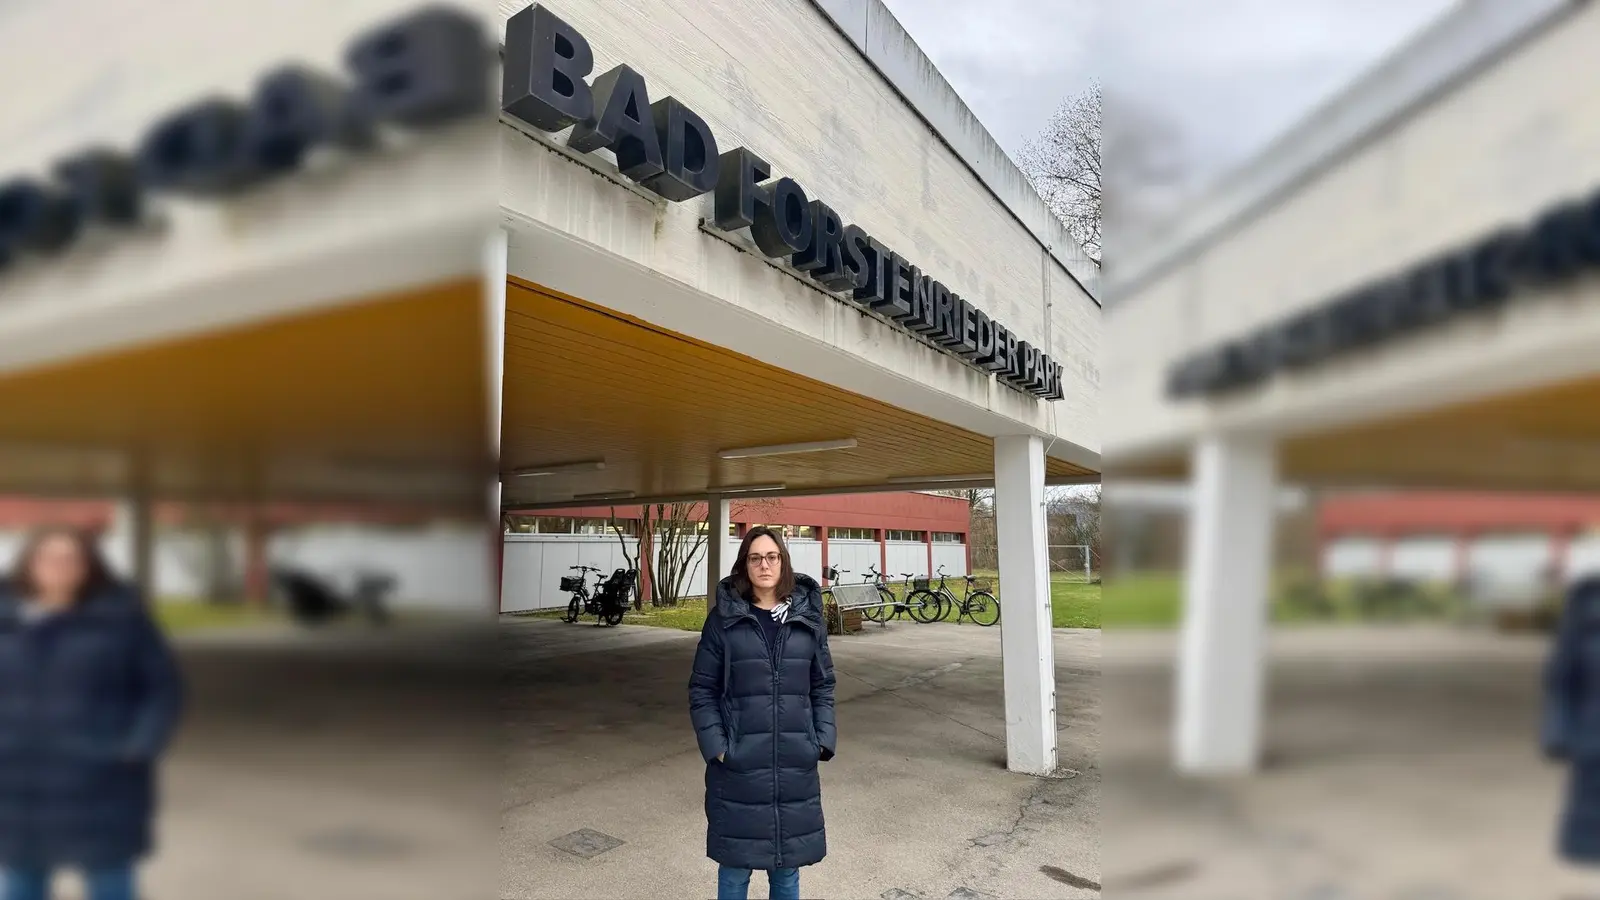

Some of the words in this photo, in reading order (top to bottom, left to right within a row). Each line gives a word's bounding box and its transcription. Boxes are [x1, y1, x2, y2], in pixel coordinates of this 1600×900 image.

[502, 2, 719, 202] BAD
[715, 146, 1020, 377] FORSTENRIEDER
[1017, 340, 1065, 400] PARK
